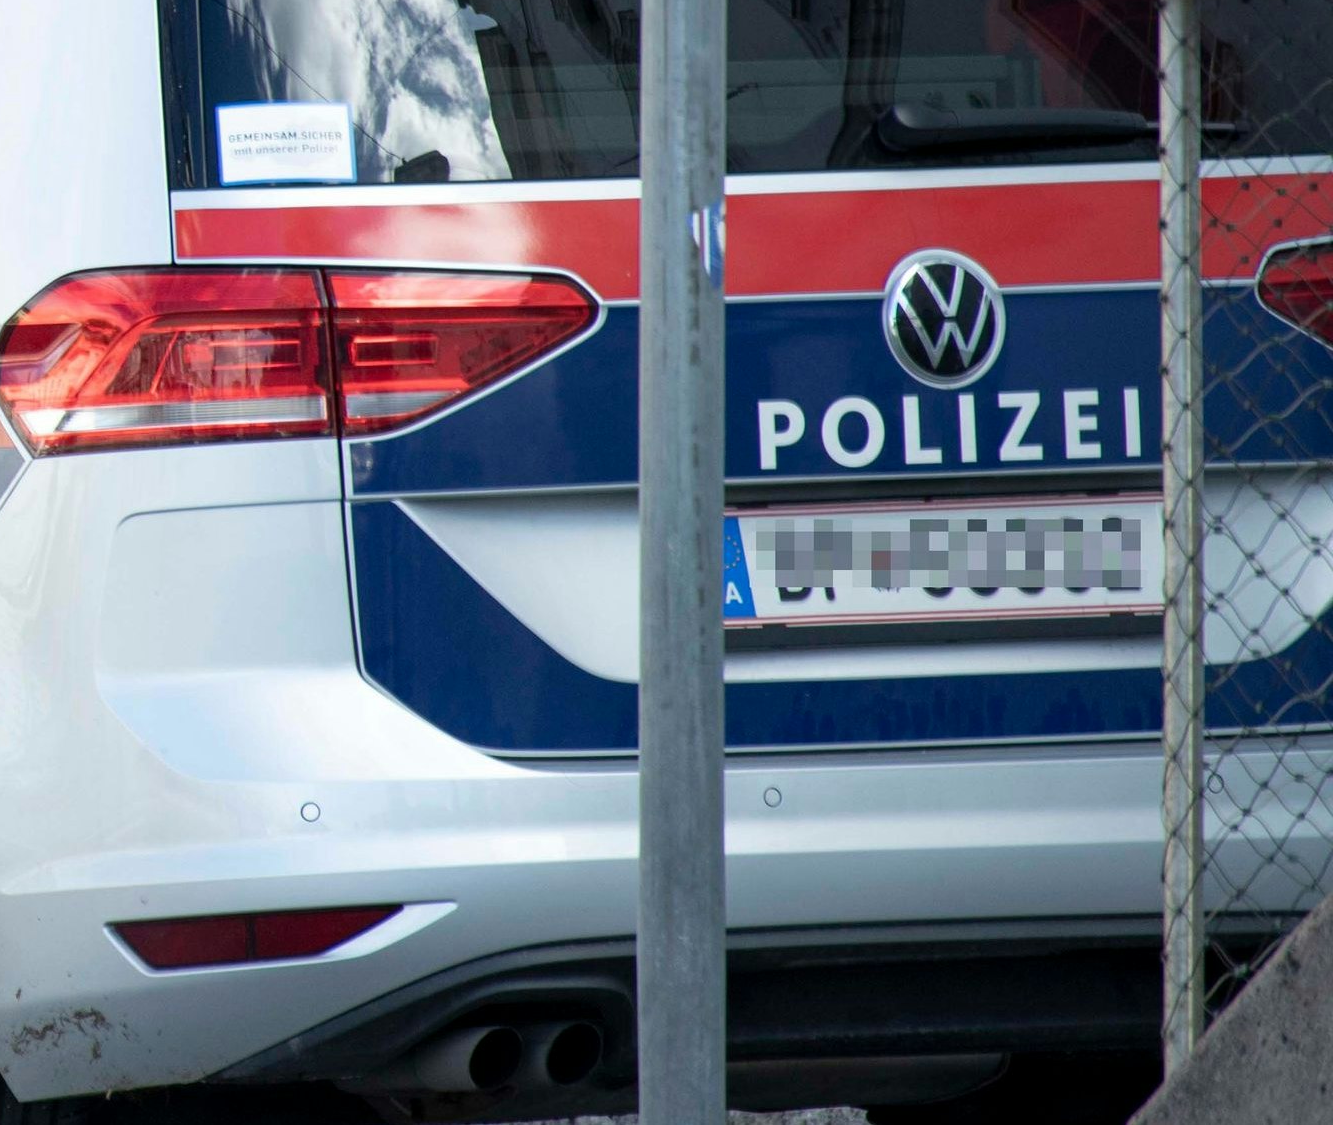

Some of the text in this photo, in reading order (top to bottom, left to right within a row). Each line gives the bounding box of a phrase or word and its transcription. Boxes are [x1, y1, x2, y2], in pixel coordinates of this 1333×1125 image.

[233, 143, 339, 156] mit unserer Polizei
[757, 386, 1142, 471] POLIZEI
[725, 580, 743, 605] A
